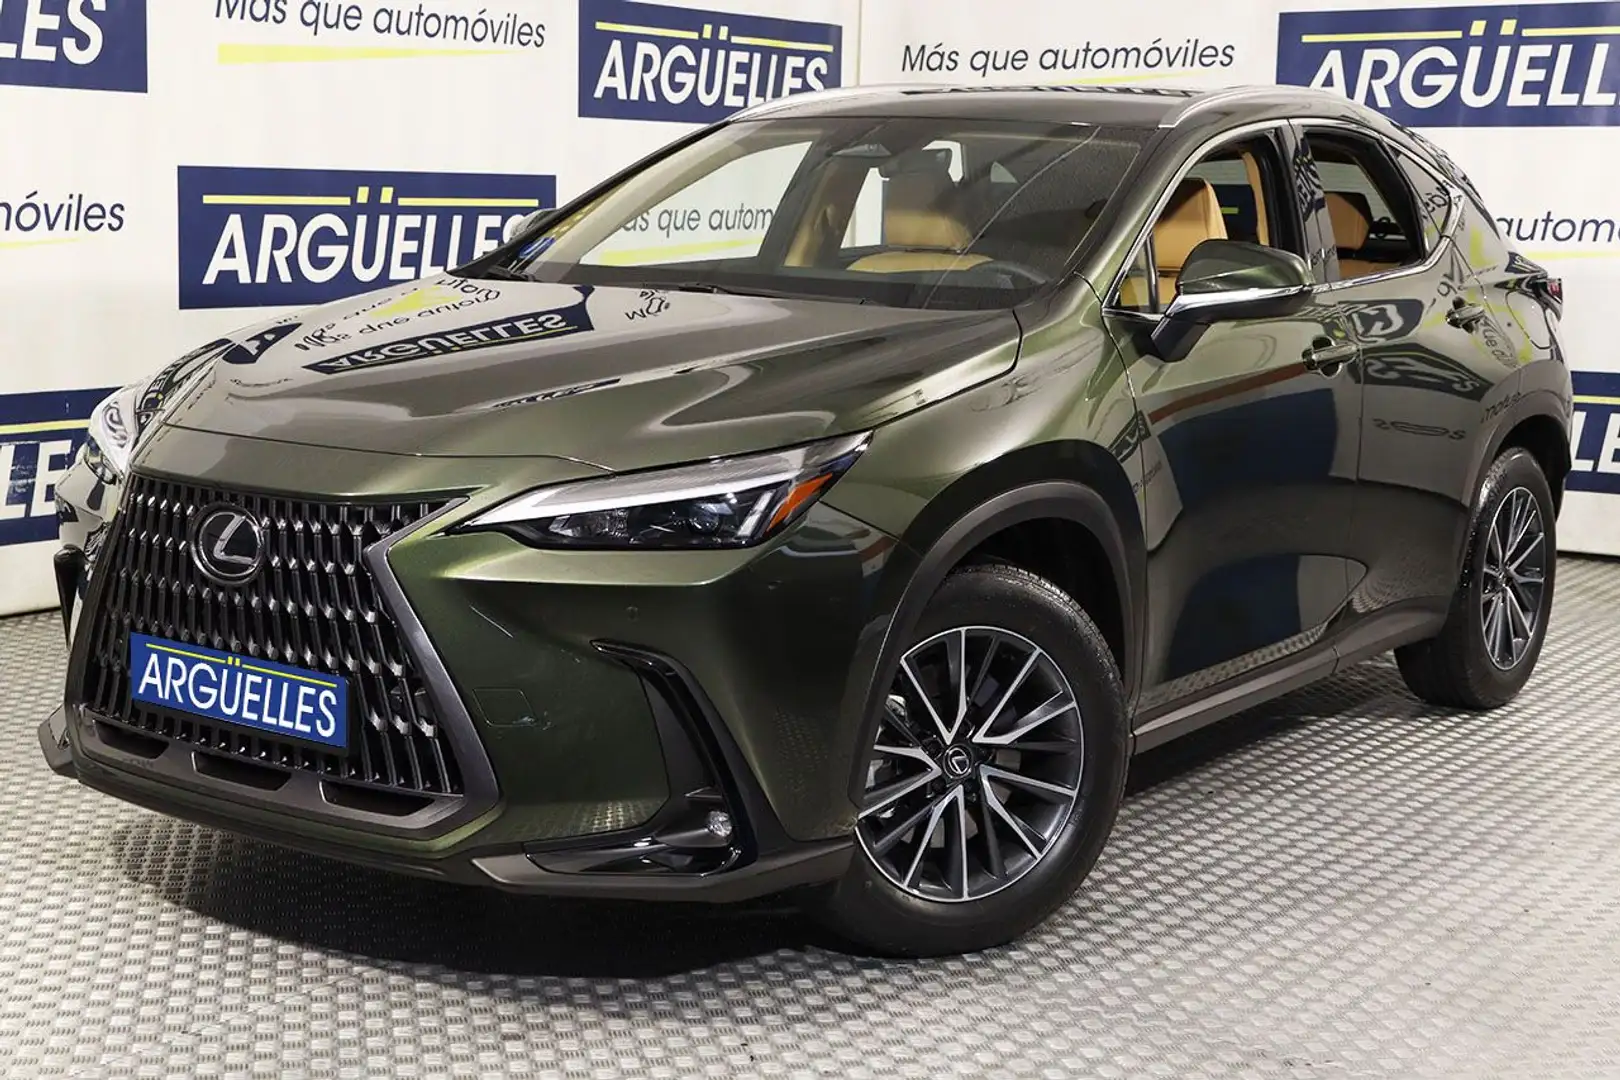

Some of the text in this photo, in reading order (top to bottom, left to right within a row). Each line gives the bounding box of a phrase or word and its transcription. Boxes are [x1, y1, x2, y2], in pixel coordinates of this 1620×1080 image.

[300, 0, 363, 36] que
[373, 4, 546, 48] automóviles
[901, 38, 1236, 77] Más que automóviles
[1309, 19, 1620, 109] ARGÜELL
[657, 208, 701, 238] que
[138, 653, 338, 739] ARGÜELLES
